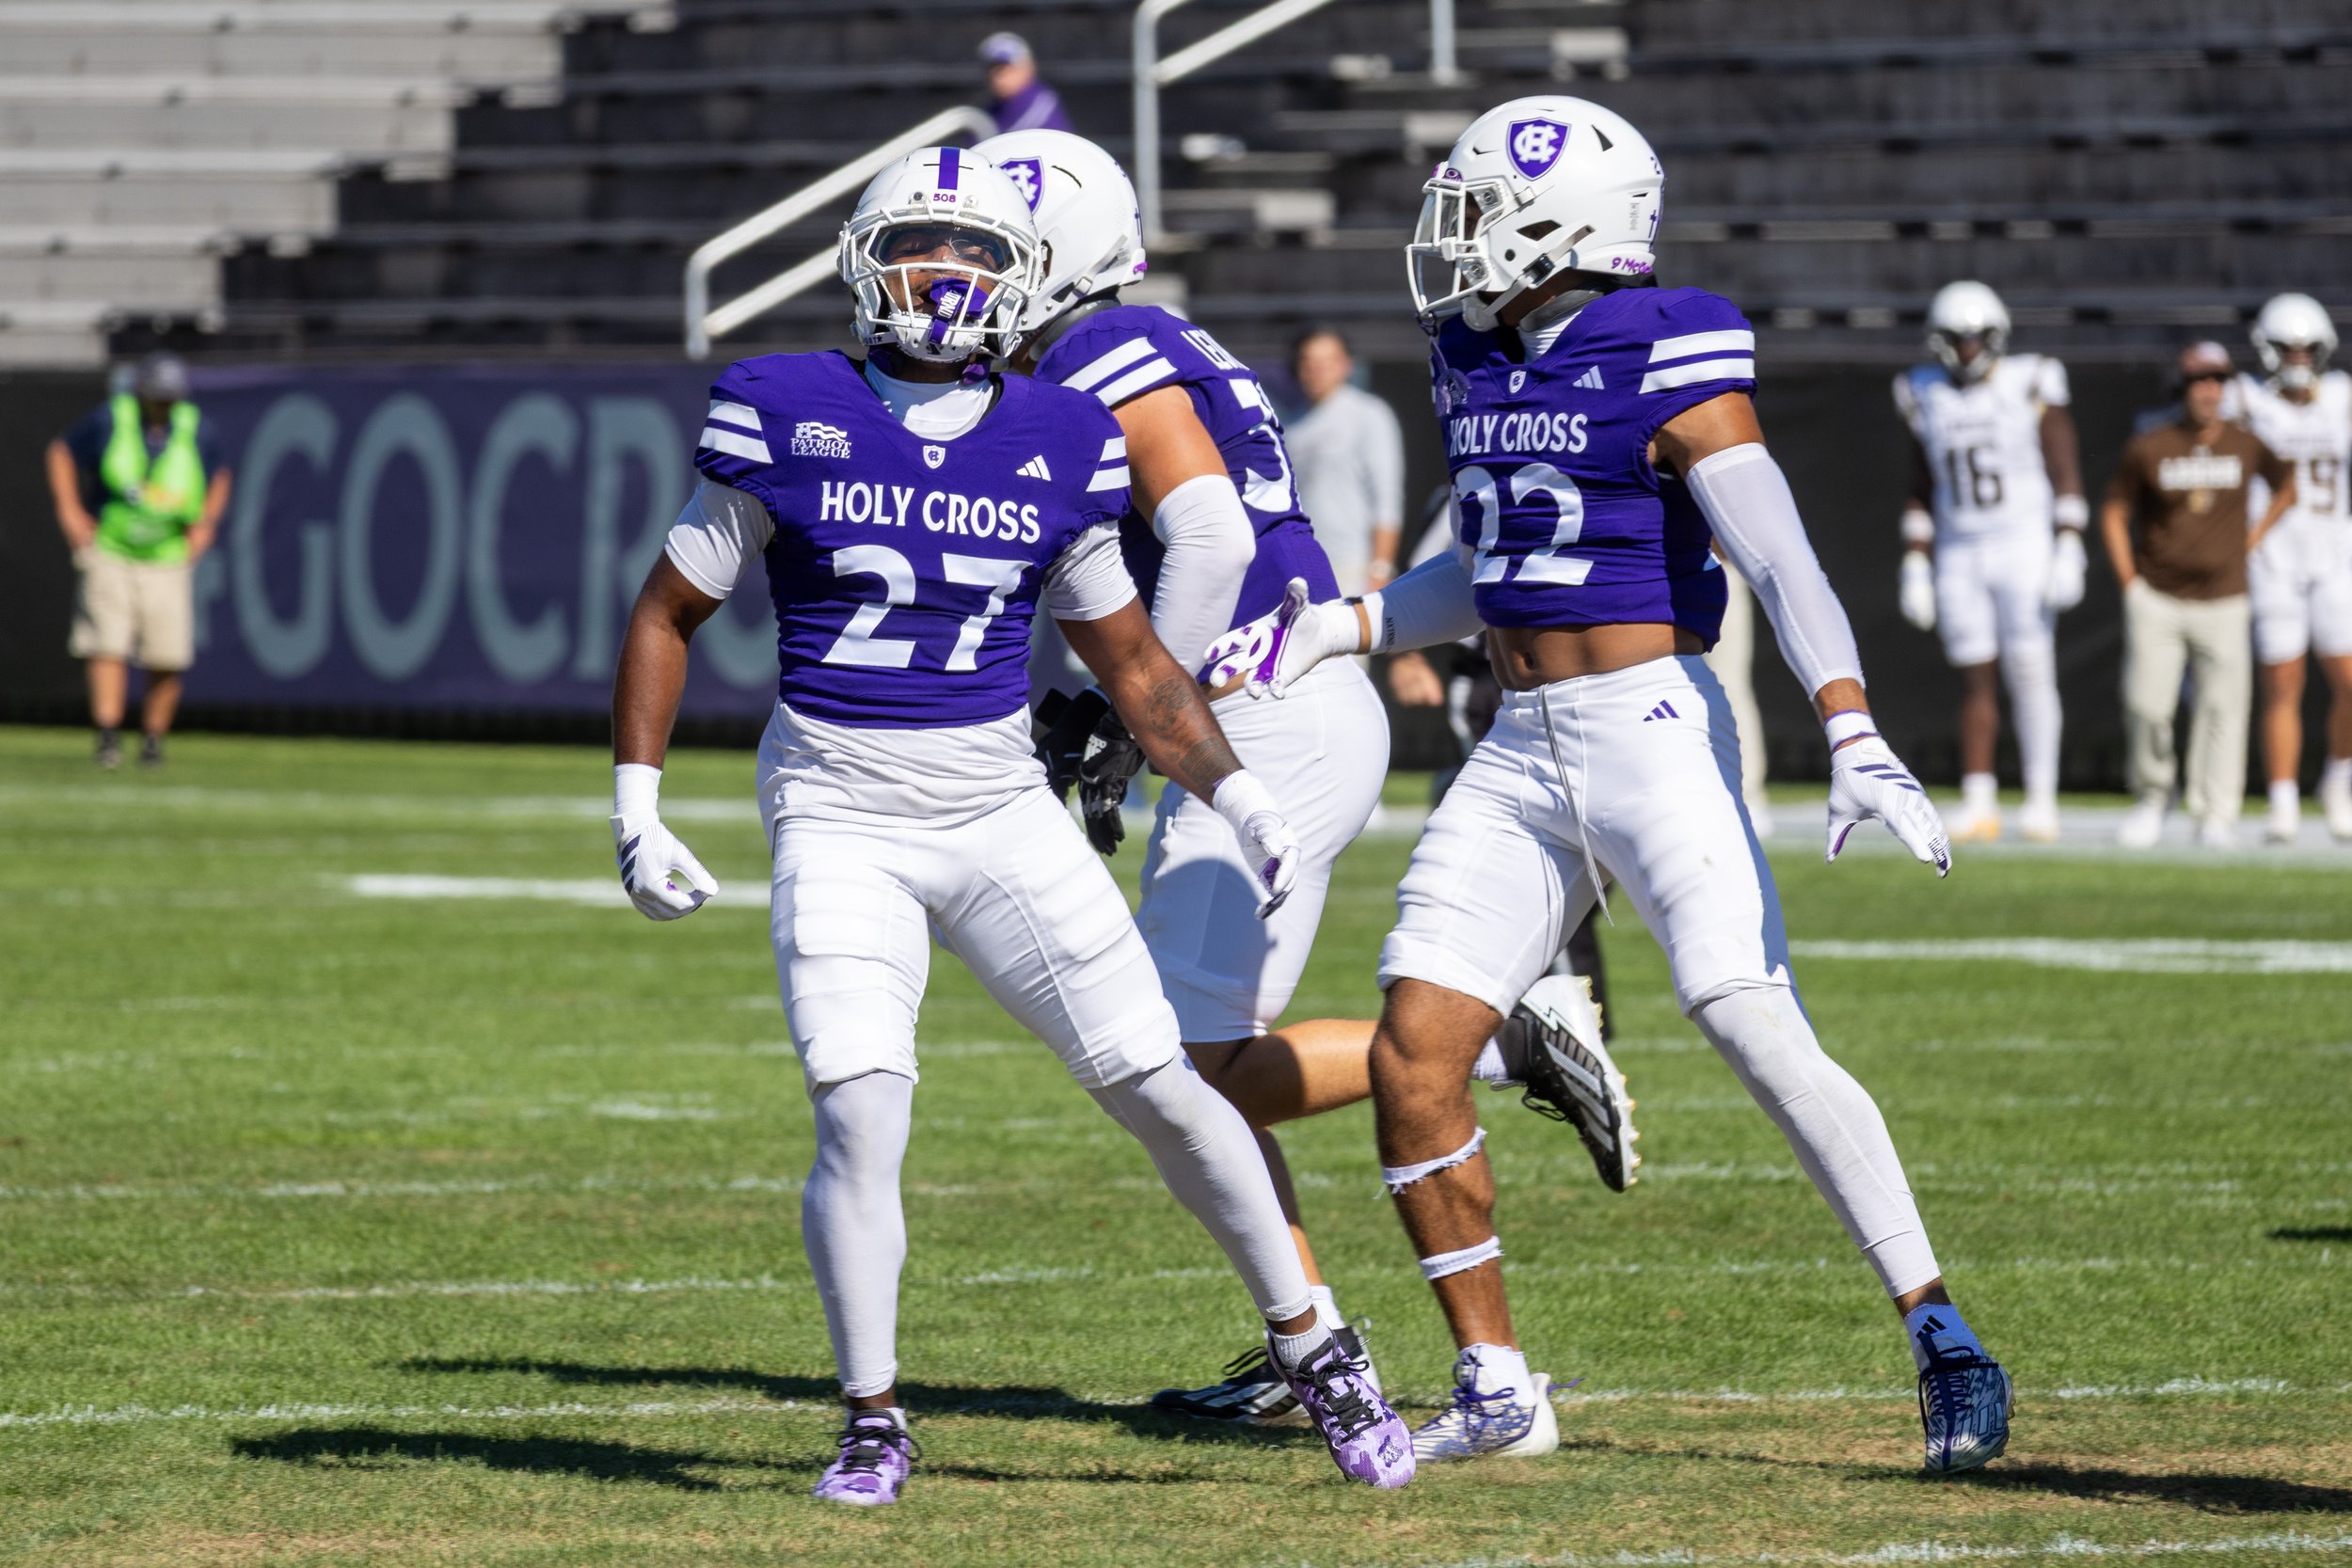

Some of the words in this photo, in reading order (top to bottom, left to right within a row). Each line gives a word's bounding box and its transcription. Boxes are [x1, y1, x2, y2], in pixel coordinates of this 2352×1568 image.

[933, 193, 956, 203] 508
[790, 437, 852, 451] PATRIOT
[791, 446, 850, 459] LEAGUE
[1228, 378, 1305, 513] 3
[1450, 415, 1500, 458] HOLY
[1501, 412, 1588, 453] CROSS
[1947, 440, 2003, 509] 16
[819, 481, 914, 527] HOLY
[922, 490, 1041, 544] CROSS
[1450, 462, 1595, 586] 22
[820, 544, 1034, 671] 27
